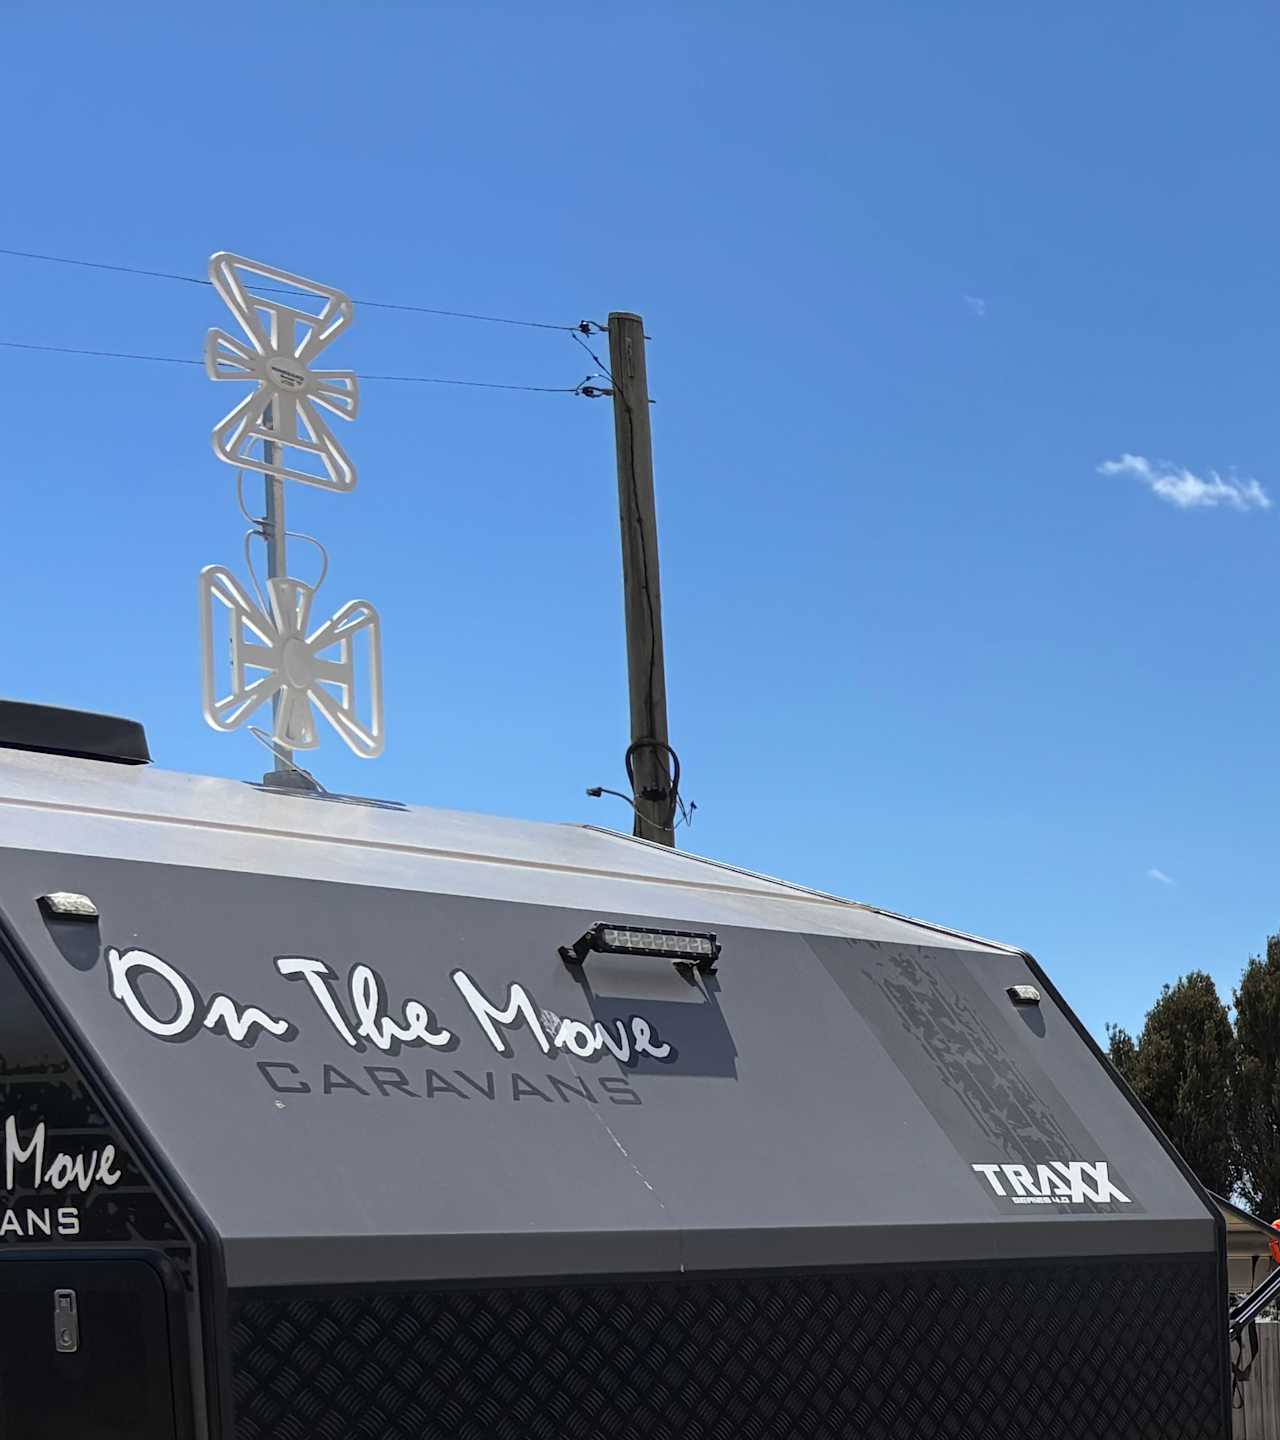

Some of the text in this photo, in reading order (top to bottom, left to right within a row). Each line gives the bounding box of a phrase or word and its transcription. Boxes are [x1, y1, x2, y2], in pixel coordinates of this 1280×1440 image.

[106, 946, 673, 1064] On The Move
[256, 1060, 643, 1106] CARAVANS
[4, 1114, 122, 1192] Move
[971, 1161, 1132, 1204] TRAXX
